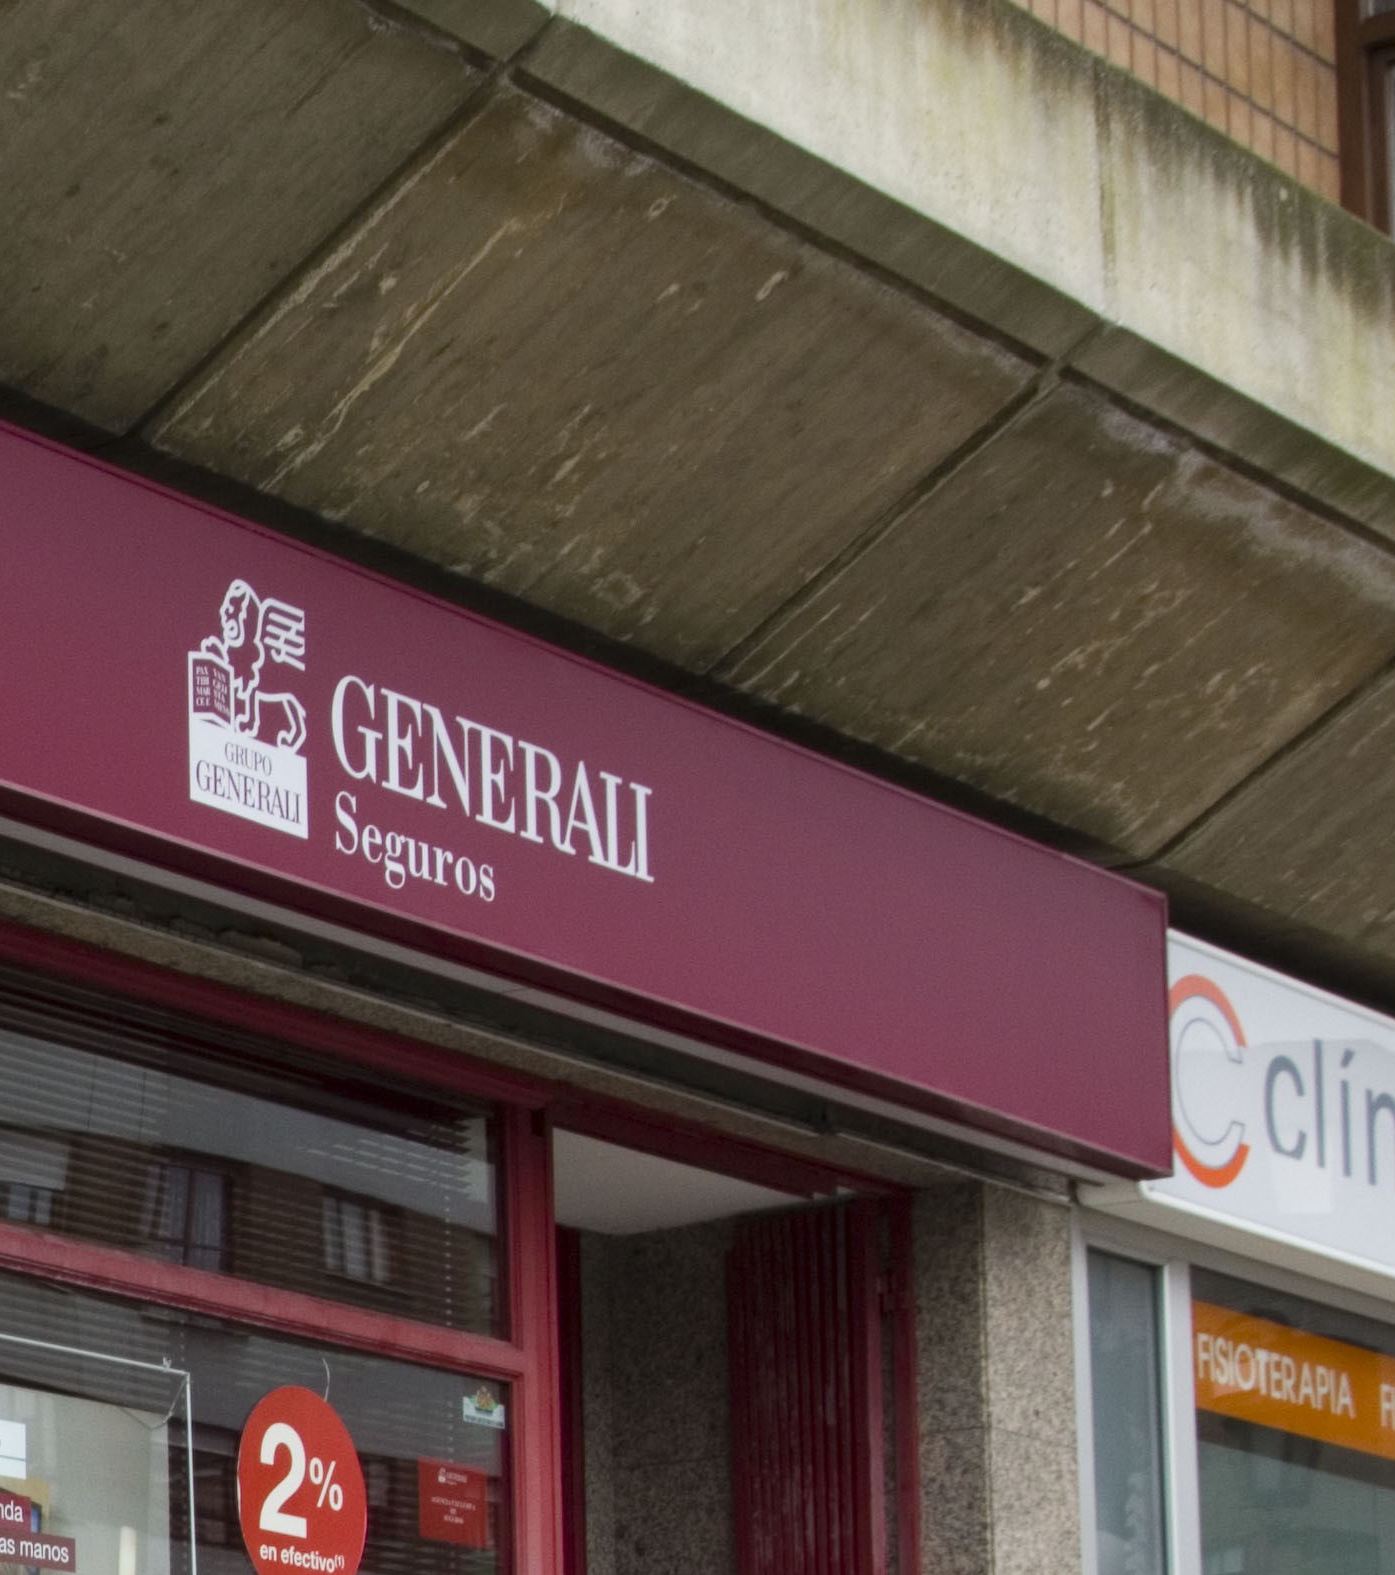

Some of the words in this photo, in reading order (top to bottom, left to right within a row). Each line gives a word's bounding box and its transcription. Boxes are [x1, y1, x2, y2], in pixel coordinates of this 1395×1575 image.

[196, 759, 301, 824] GENERALI
[224, 741, 272, 776] GRUPO
[331, 675, 654, 882] GENERALI
[334, 790, 495, 902] Seguros
[1196, 1332, 1356, 1419] FISIOTERAPIA
[260, 1422, 343, 1538] 2%
[20, 1540, 69, 1563] manos
[260, 1544, 277, 1562] en
